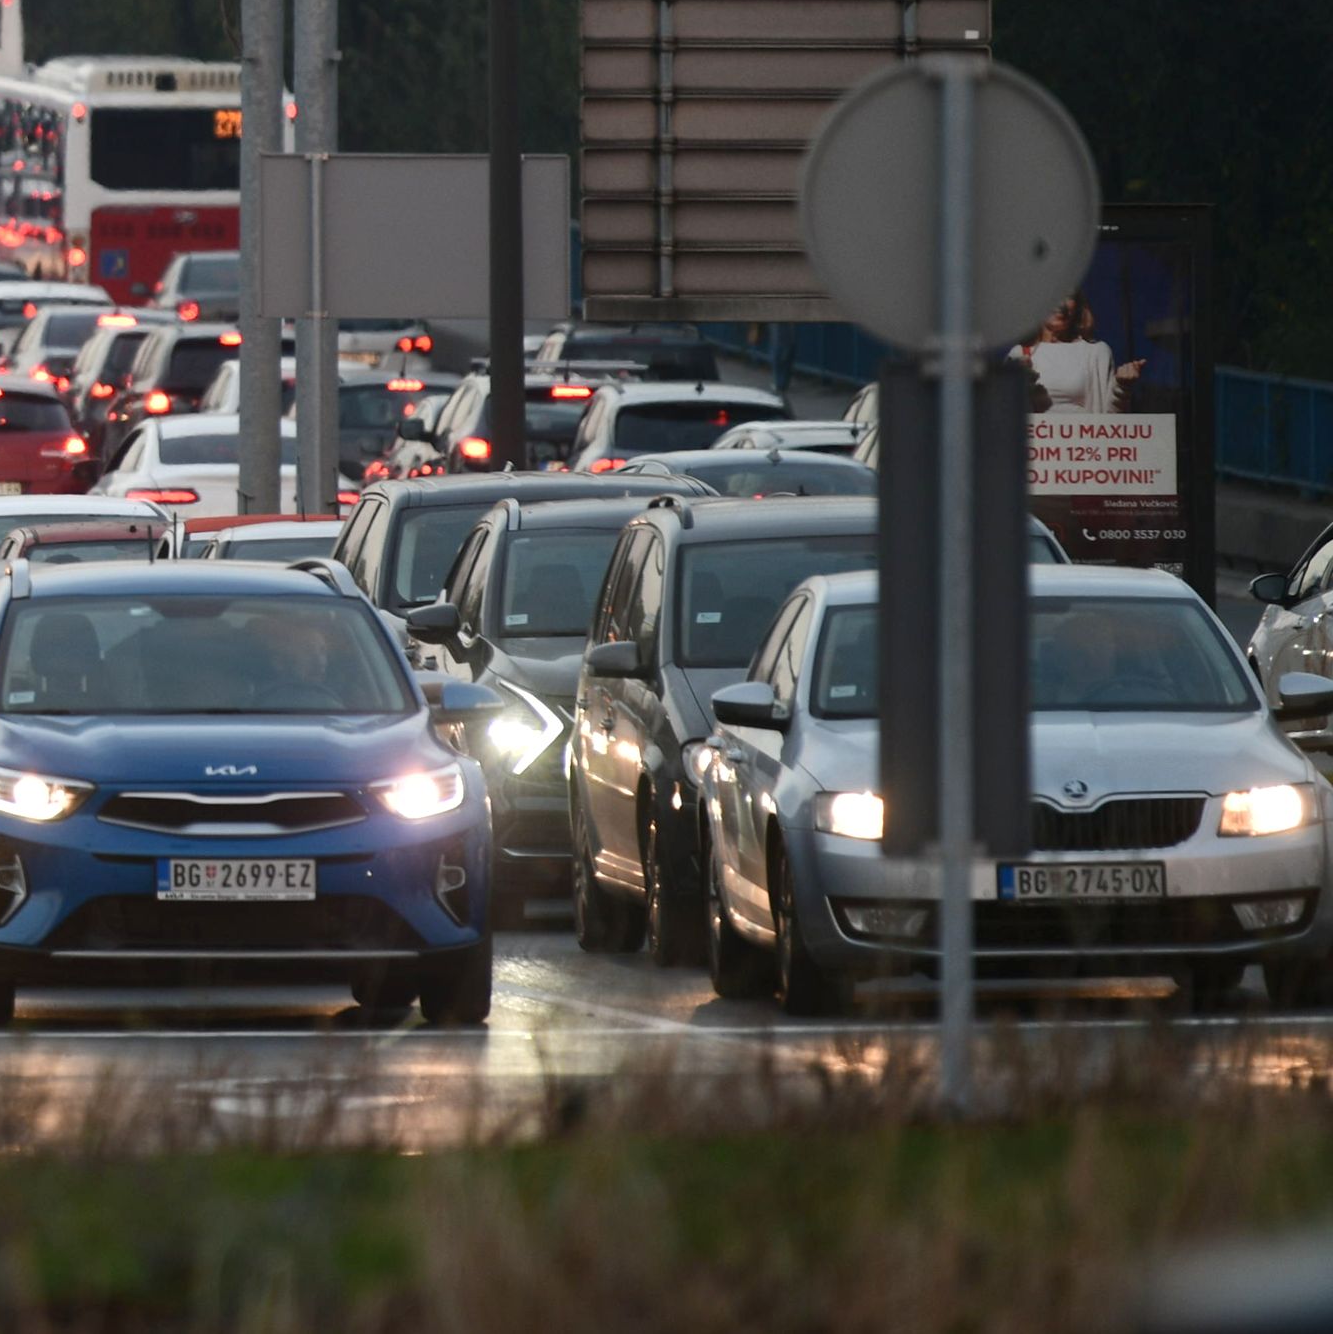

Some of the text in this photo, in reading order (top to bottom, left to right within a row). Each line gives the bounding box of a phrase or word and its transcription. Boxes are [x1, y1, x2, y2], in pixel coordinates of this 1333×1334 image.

[1060, 424, 1073, 439] U
[1080, 424, 1153, 439] MAXIJU
[1067, 447, 1102, 462] 12%
[1107, 447, 1138, 462] PRI
[1099, 529, 1187, 540] 0800 3537 030
[173, 863, 201, 888] BG
[1018, 869, 1047, 895] BG
